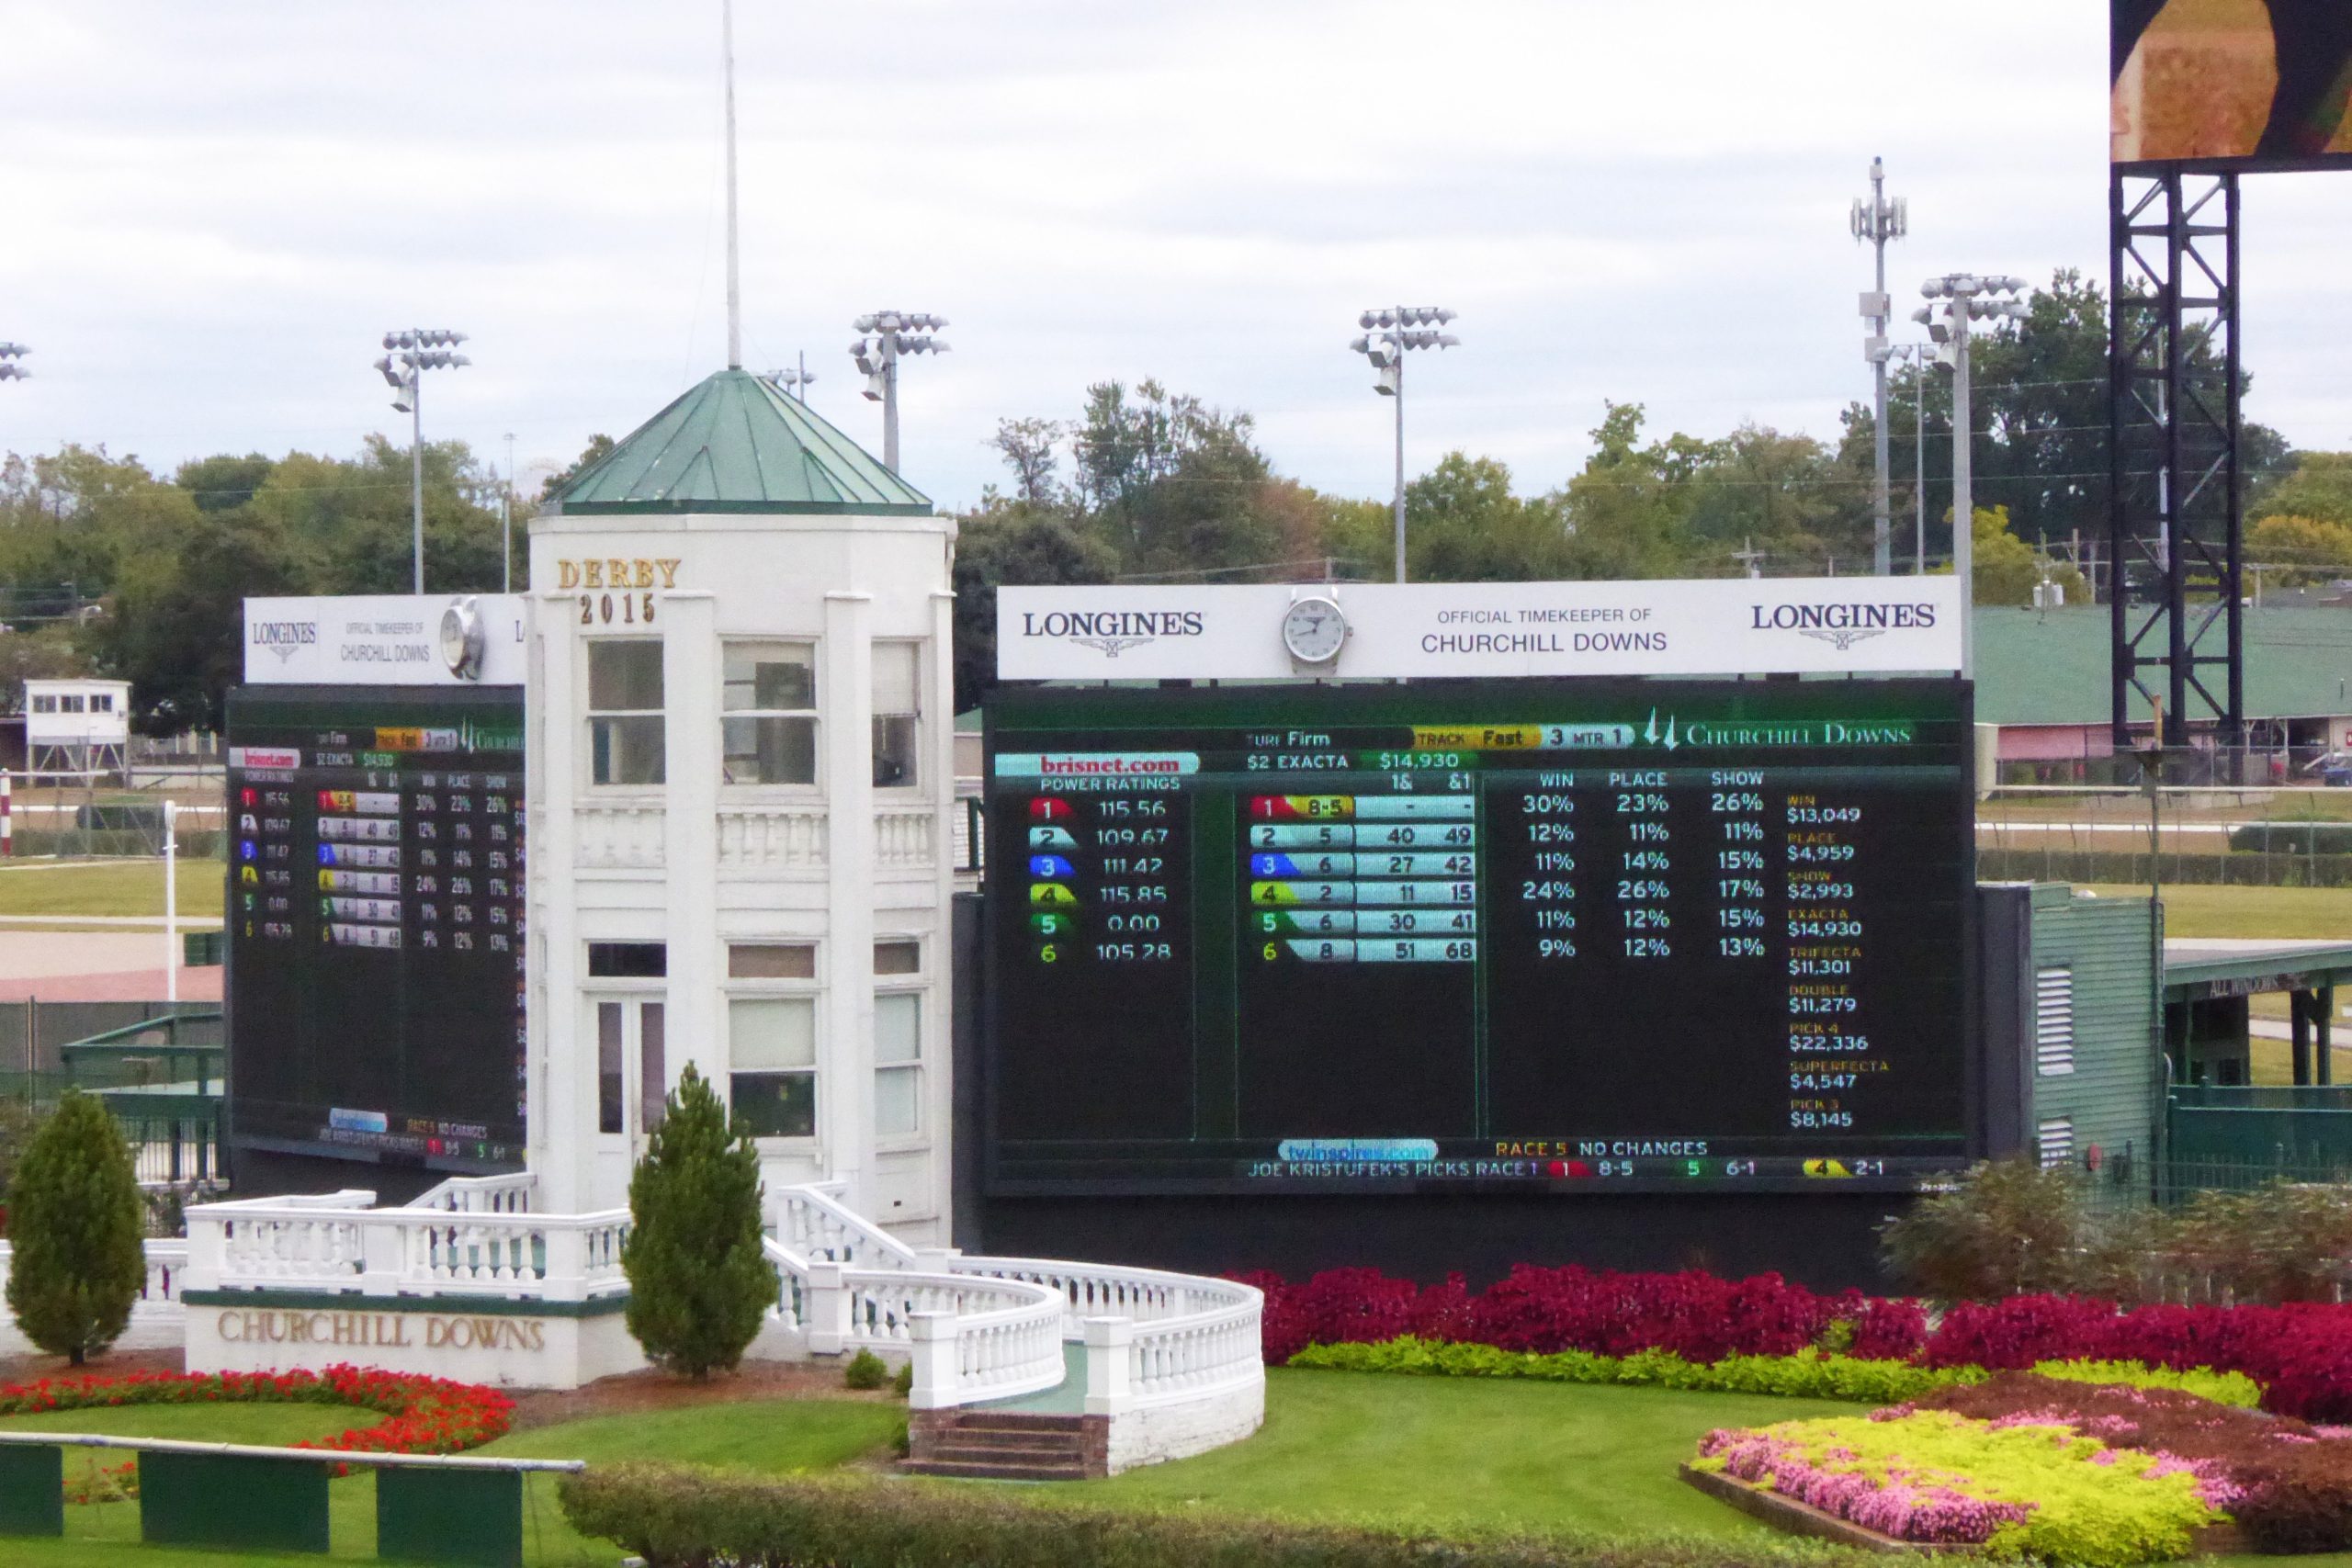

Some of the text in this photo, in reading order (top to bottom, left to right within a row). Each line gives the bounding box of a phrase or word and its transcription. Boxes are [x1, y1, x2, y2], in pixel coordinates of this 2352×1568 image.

[559, 558, 681, 588] DERBY
[581, 593, 654, 624] 2015
[1438, 608, 1651, 624] OFFICIAL TIMEKEEPER OF
[1751, 604, 1935, 628] LONGINES
[253, 622, 316, 644] LONGINES
[1023, 612, 1203, 636] LONGINES
[1421, 632, 1667, 653] CHURCHILL DOWNS
[341, 645, 430, 661] CHURCHILL DOWNS
[1288, 731, 1329, 746] Firm
[1483, 729, 1522, 746] Fast
[1550, 728, 1622, 746] 3 MTR 1
[1040, 755, 1180, 773] brisnet.com
[1247, 752, 1459, 770] $2 EXACTA $14,930
[1041, 777, 1181, 791] POWER RATINGS
[1540, 772, 1764, 787] WIN PLACE SHOW
[1043, 801, 1051, 818] 1
[1264, 799, 1342, 817] 1 8-5
[1522, 793, 1764, 813] 30% 23% 26%
[1787, 807, 1861, 824] $13,049
[1041, 829, 1054, 845] 2
[1262, 828, 1471, 845] 2 5 40 49
[1529, 822, 1764, 841] 12% 11% 11%
[1535, 852, 1764, 871] 11% 14% 15%
[1787, 844, 1854, 862] $4,959
[1040, 858, 1055, 876] 3
[1263, 856, 1471, 874] 3 6 27 42
[1040, 886, 1055, 900] 4
[1262, 885, 1472, 901] 4 2 11 15
[1522, 879, 1765, 899] 24% 26% 17%
[1788, 883, 1854, 900] $2,993
[1042, 915, 1056, 934] 5
[1263, 914, 1472, 931] 5 6 30 41
[1537, 909, 1765, 929] 11% 12% 15%
[1788, 920, 1861, 937] $14,930
[1041, 943, 1057, 963] 6
[1263, 942, 1473, 961] 6 8 51 68
[1539, 938, 1765, 957] 9% 12% 13%
[1790, 1034, 1869, 1052] $22,336
[1790, 1073, 1857, 1090] $4,547
[1791, 1111, 1853, 1128] $8,145
[1497, 1142, 1708, 1156] RACE 5 NO CHANGES
[1249, 1160, 1883, 1177] JOE KRISTUFEK'S PICKS RACE 1 1 8-5 5 6-1 4 2-1
[218, 1311, 546, 1351] CHURCHILL DOWNS
